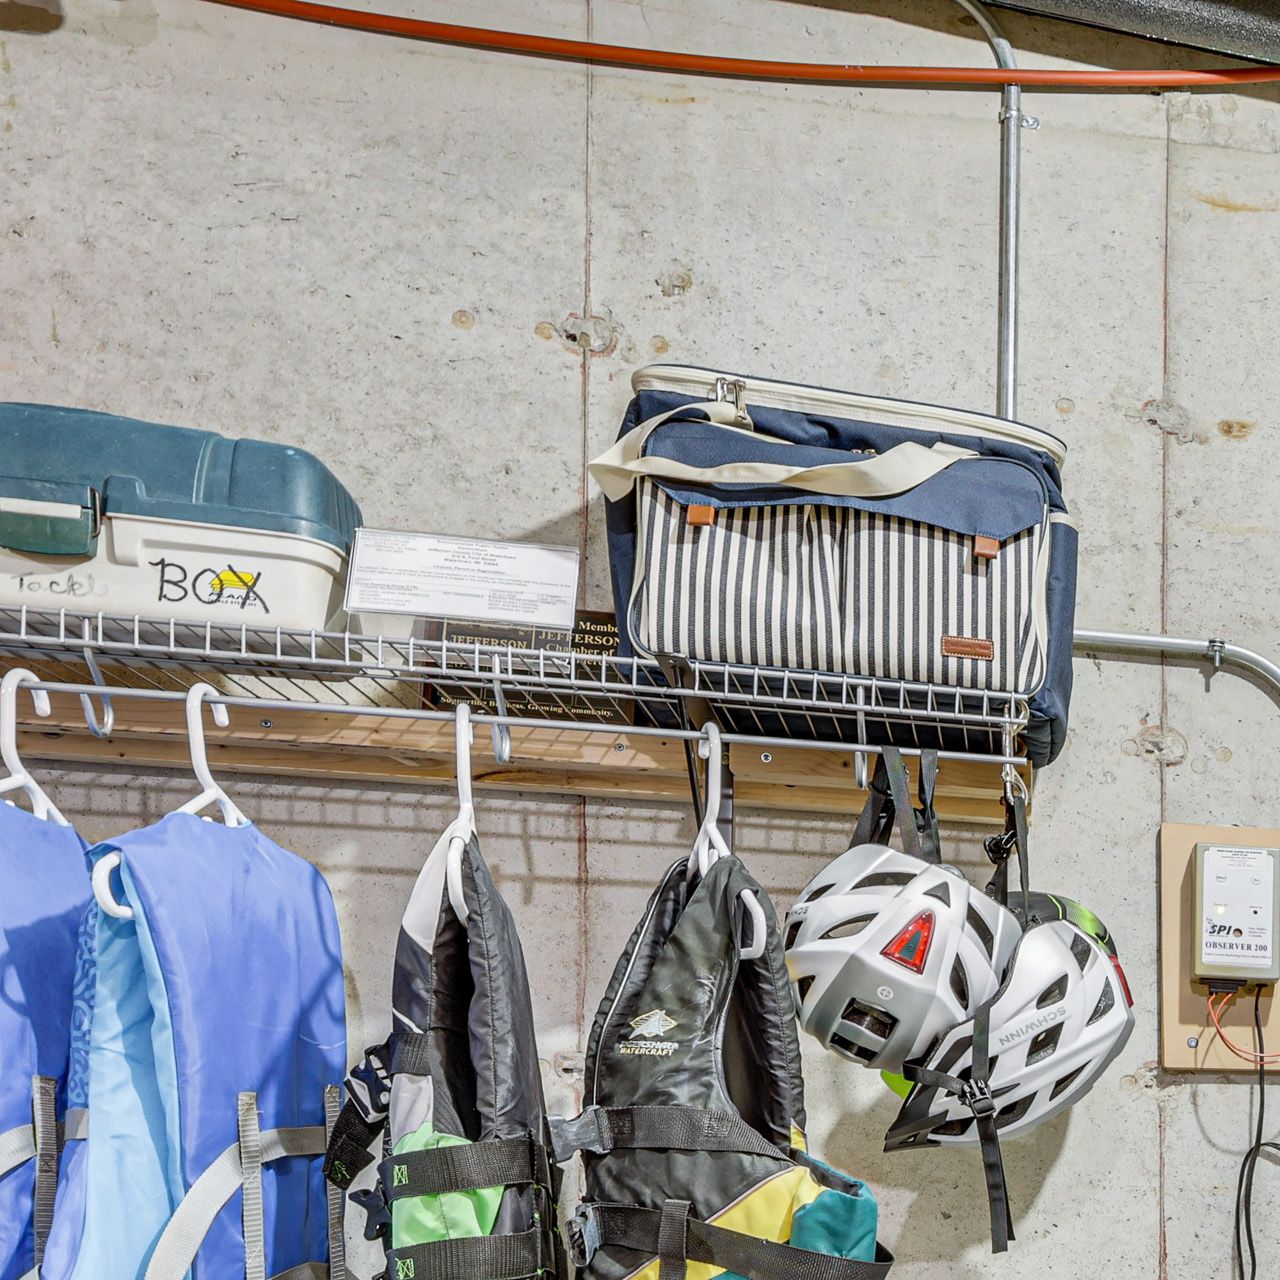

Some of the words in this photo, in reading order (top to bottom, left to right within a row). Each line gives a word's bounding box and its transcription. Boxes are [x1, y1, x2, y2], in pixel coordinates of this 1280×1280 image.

[149, 558, 270, 614] BOX
[1209, 924, 1232, 936] SPI
[1205, 940, 1253, 952] OBSERVER
[1254, 944, 1268, 952] 200
[999, 1006, 1067, 1046] SCHWINN
[619, 1047, 675, 1056] WATERCRAFT
